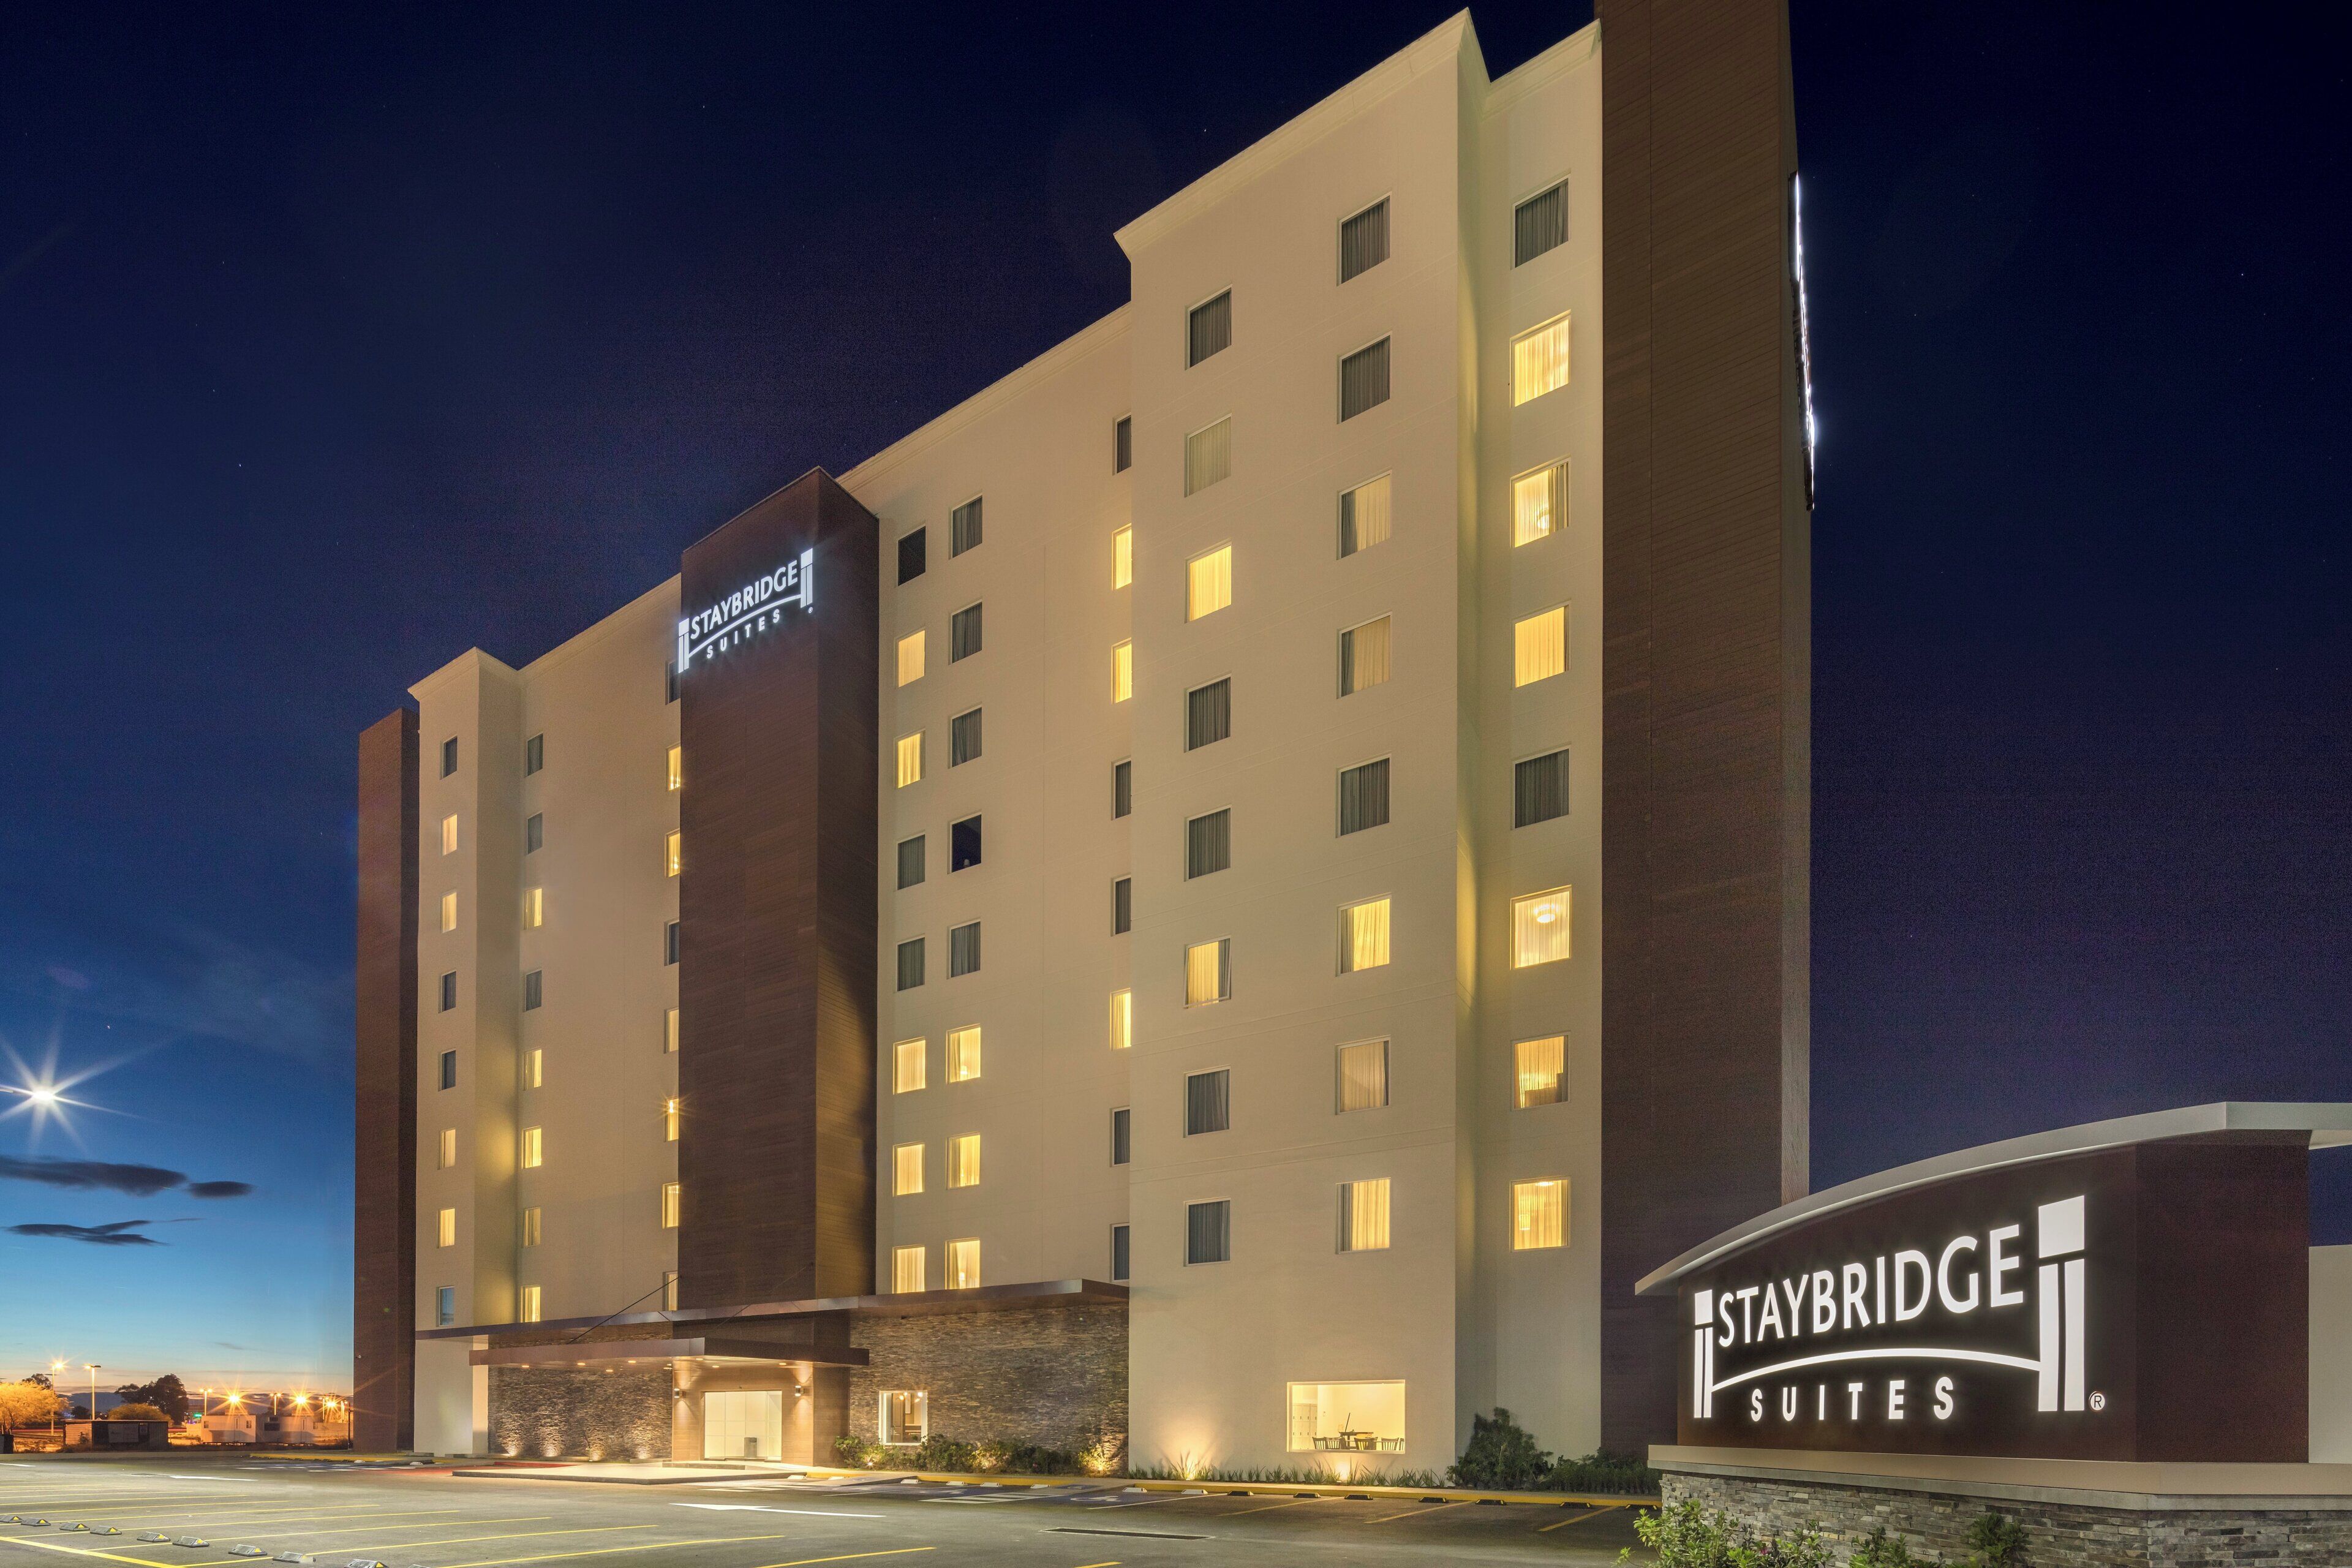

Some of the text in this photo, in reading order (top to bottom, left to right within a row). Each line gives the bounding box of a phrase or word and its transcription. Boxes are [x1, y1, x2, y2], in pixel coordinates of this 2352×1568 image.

[690, 560, 798, 639] STAYBRIDGE
[706, 609, 780, 659] SUITES
[1718, 1224, 2024, 1348] STAYBRIDGE
[1750, 1376, 1954, 1422] SUITES
